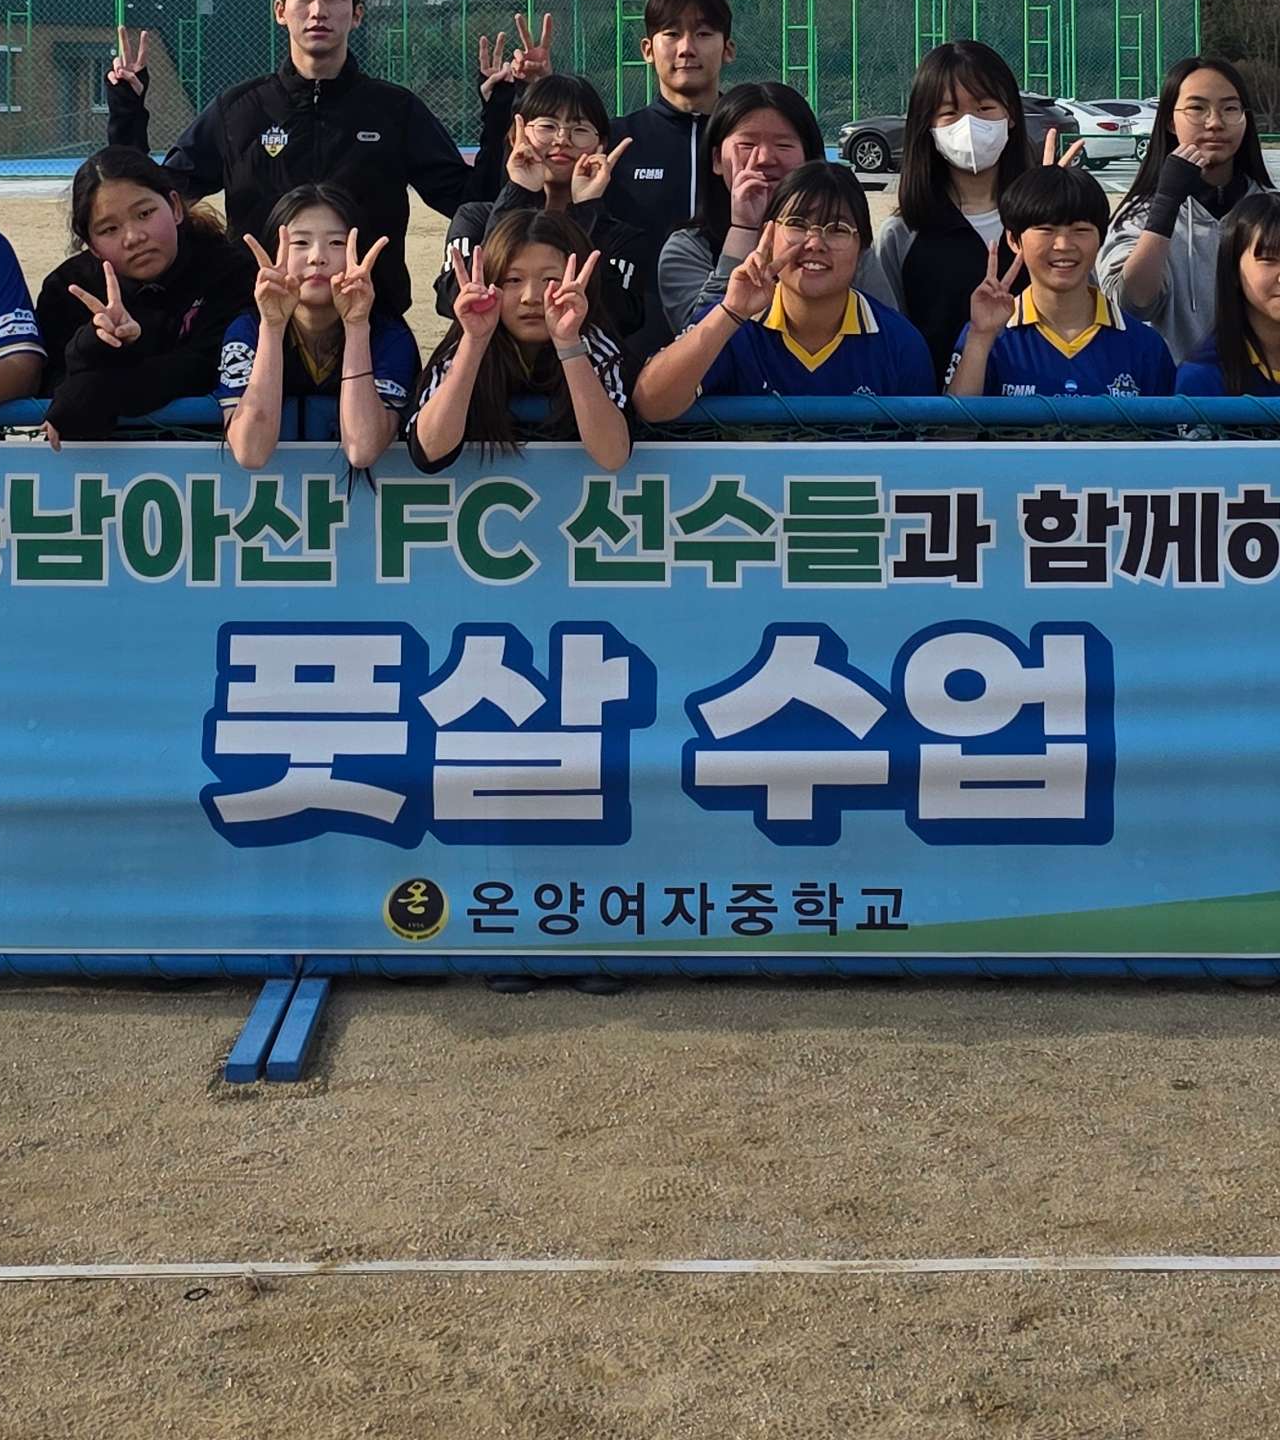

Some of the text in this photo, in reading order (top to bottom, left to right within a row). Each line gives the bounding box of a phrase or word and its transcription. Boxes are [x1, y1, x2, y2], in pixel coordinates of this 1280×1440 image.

[377, 477, 538, 584] FC
[564, 474, 994, 587] 선수들과
[207, 626, 1101, 836] 풋살 수업
[466, 880, 910, 937] 온양여자중학교
